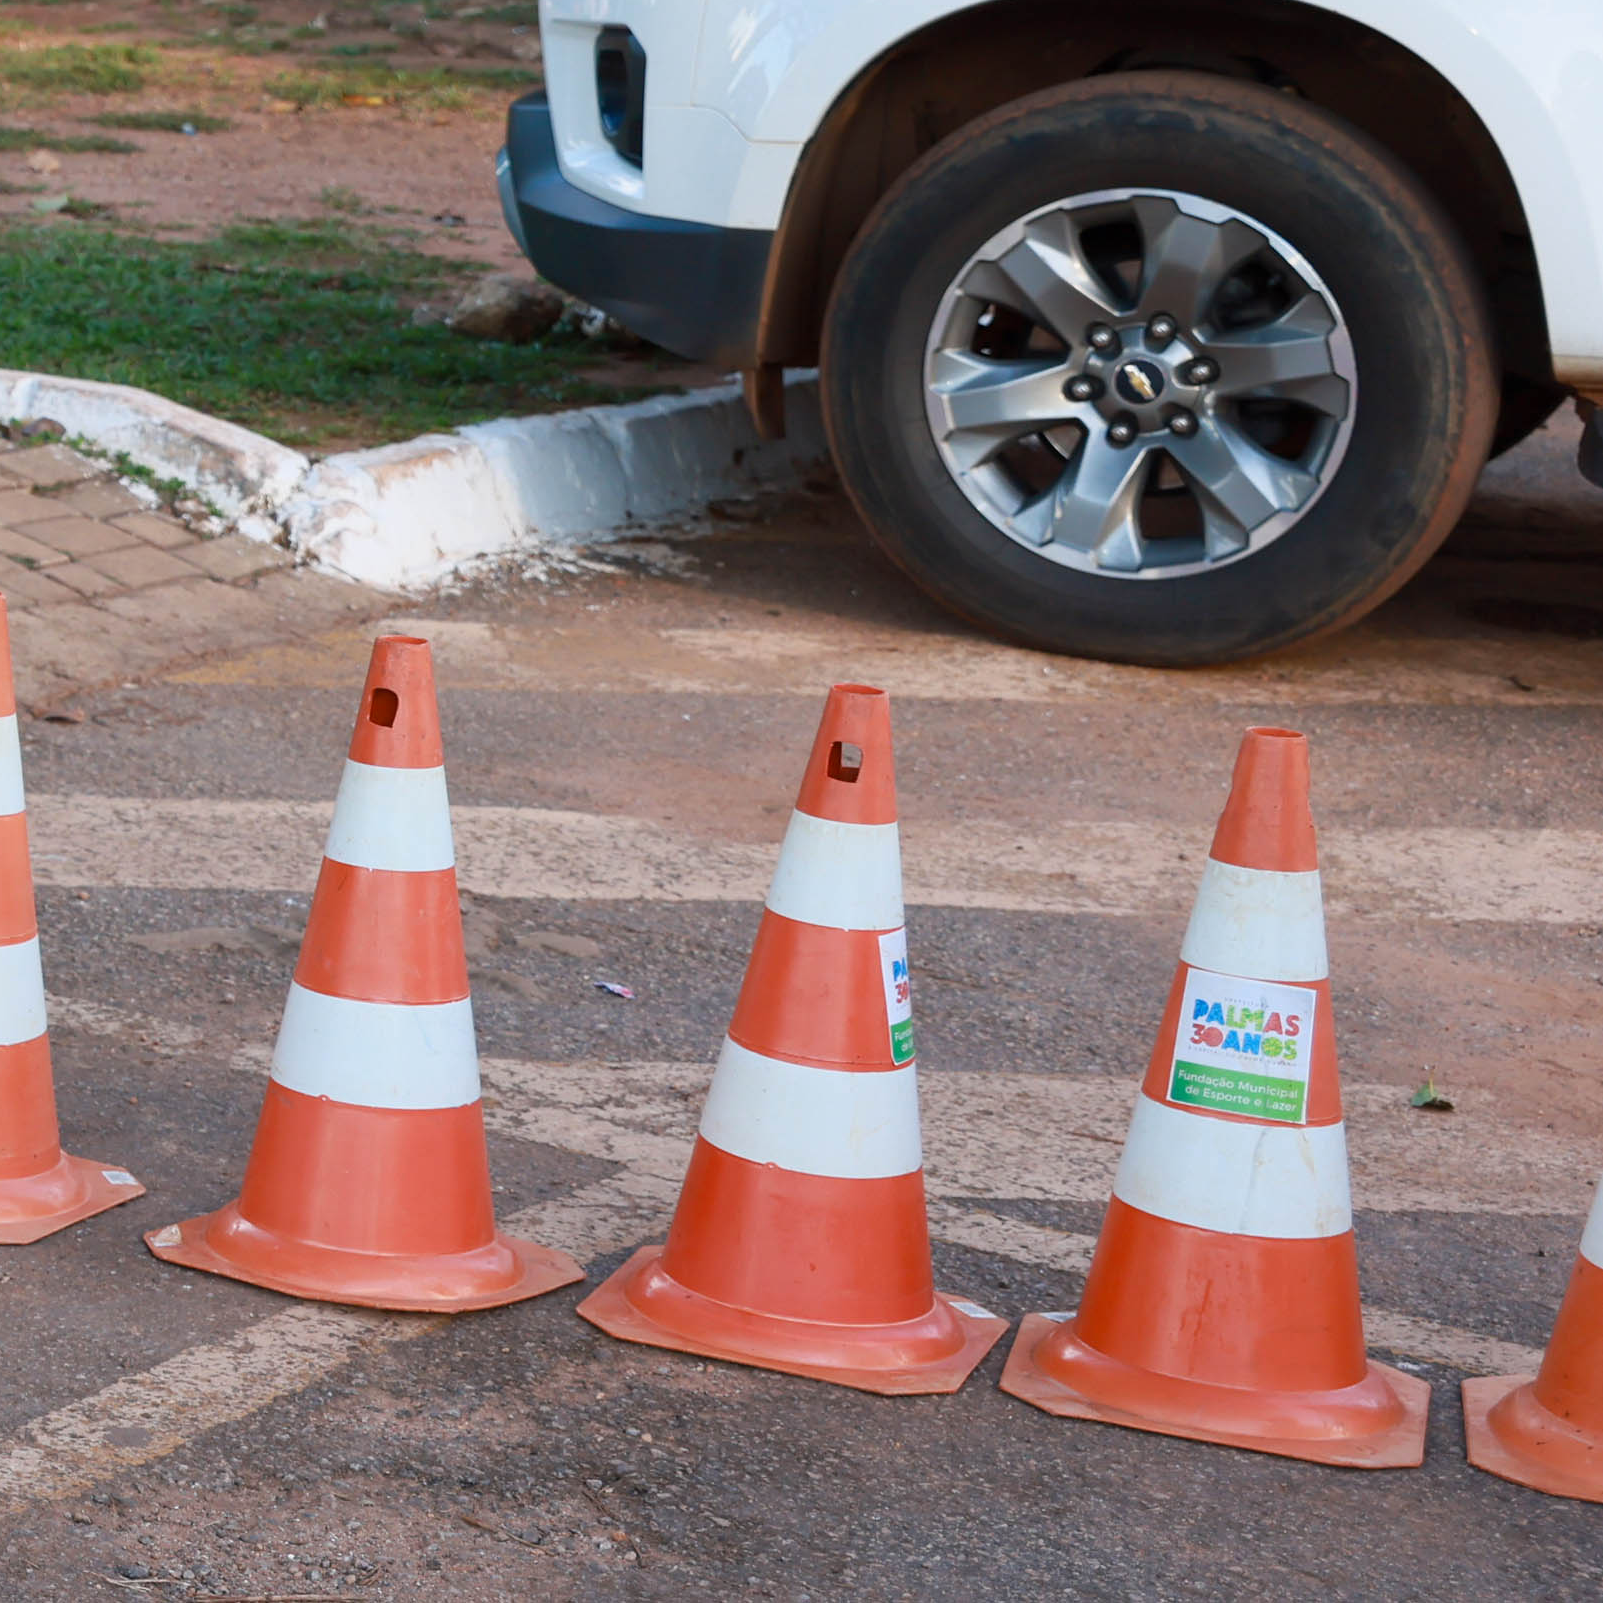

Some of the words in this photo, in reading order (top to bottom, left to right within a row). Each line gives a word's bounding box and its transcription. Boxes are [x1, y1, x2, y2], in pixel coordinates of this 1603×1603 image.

[1192, 998, 1301, 1037] PALMAS
[1177, 1068, 1235, 1091] Fundação
[1238, 1080, 1299, 1100] Municipal
[1185, 1085, 1199, 1096] de
[1202, 1088, 1250, 1106] Esporte
[1253, 1097, 1262, 1107] e
[1266, 1098, 1298, 1112] Lazer
